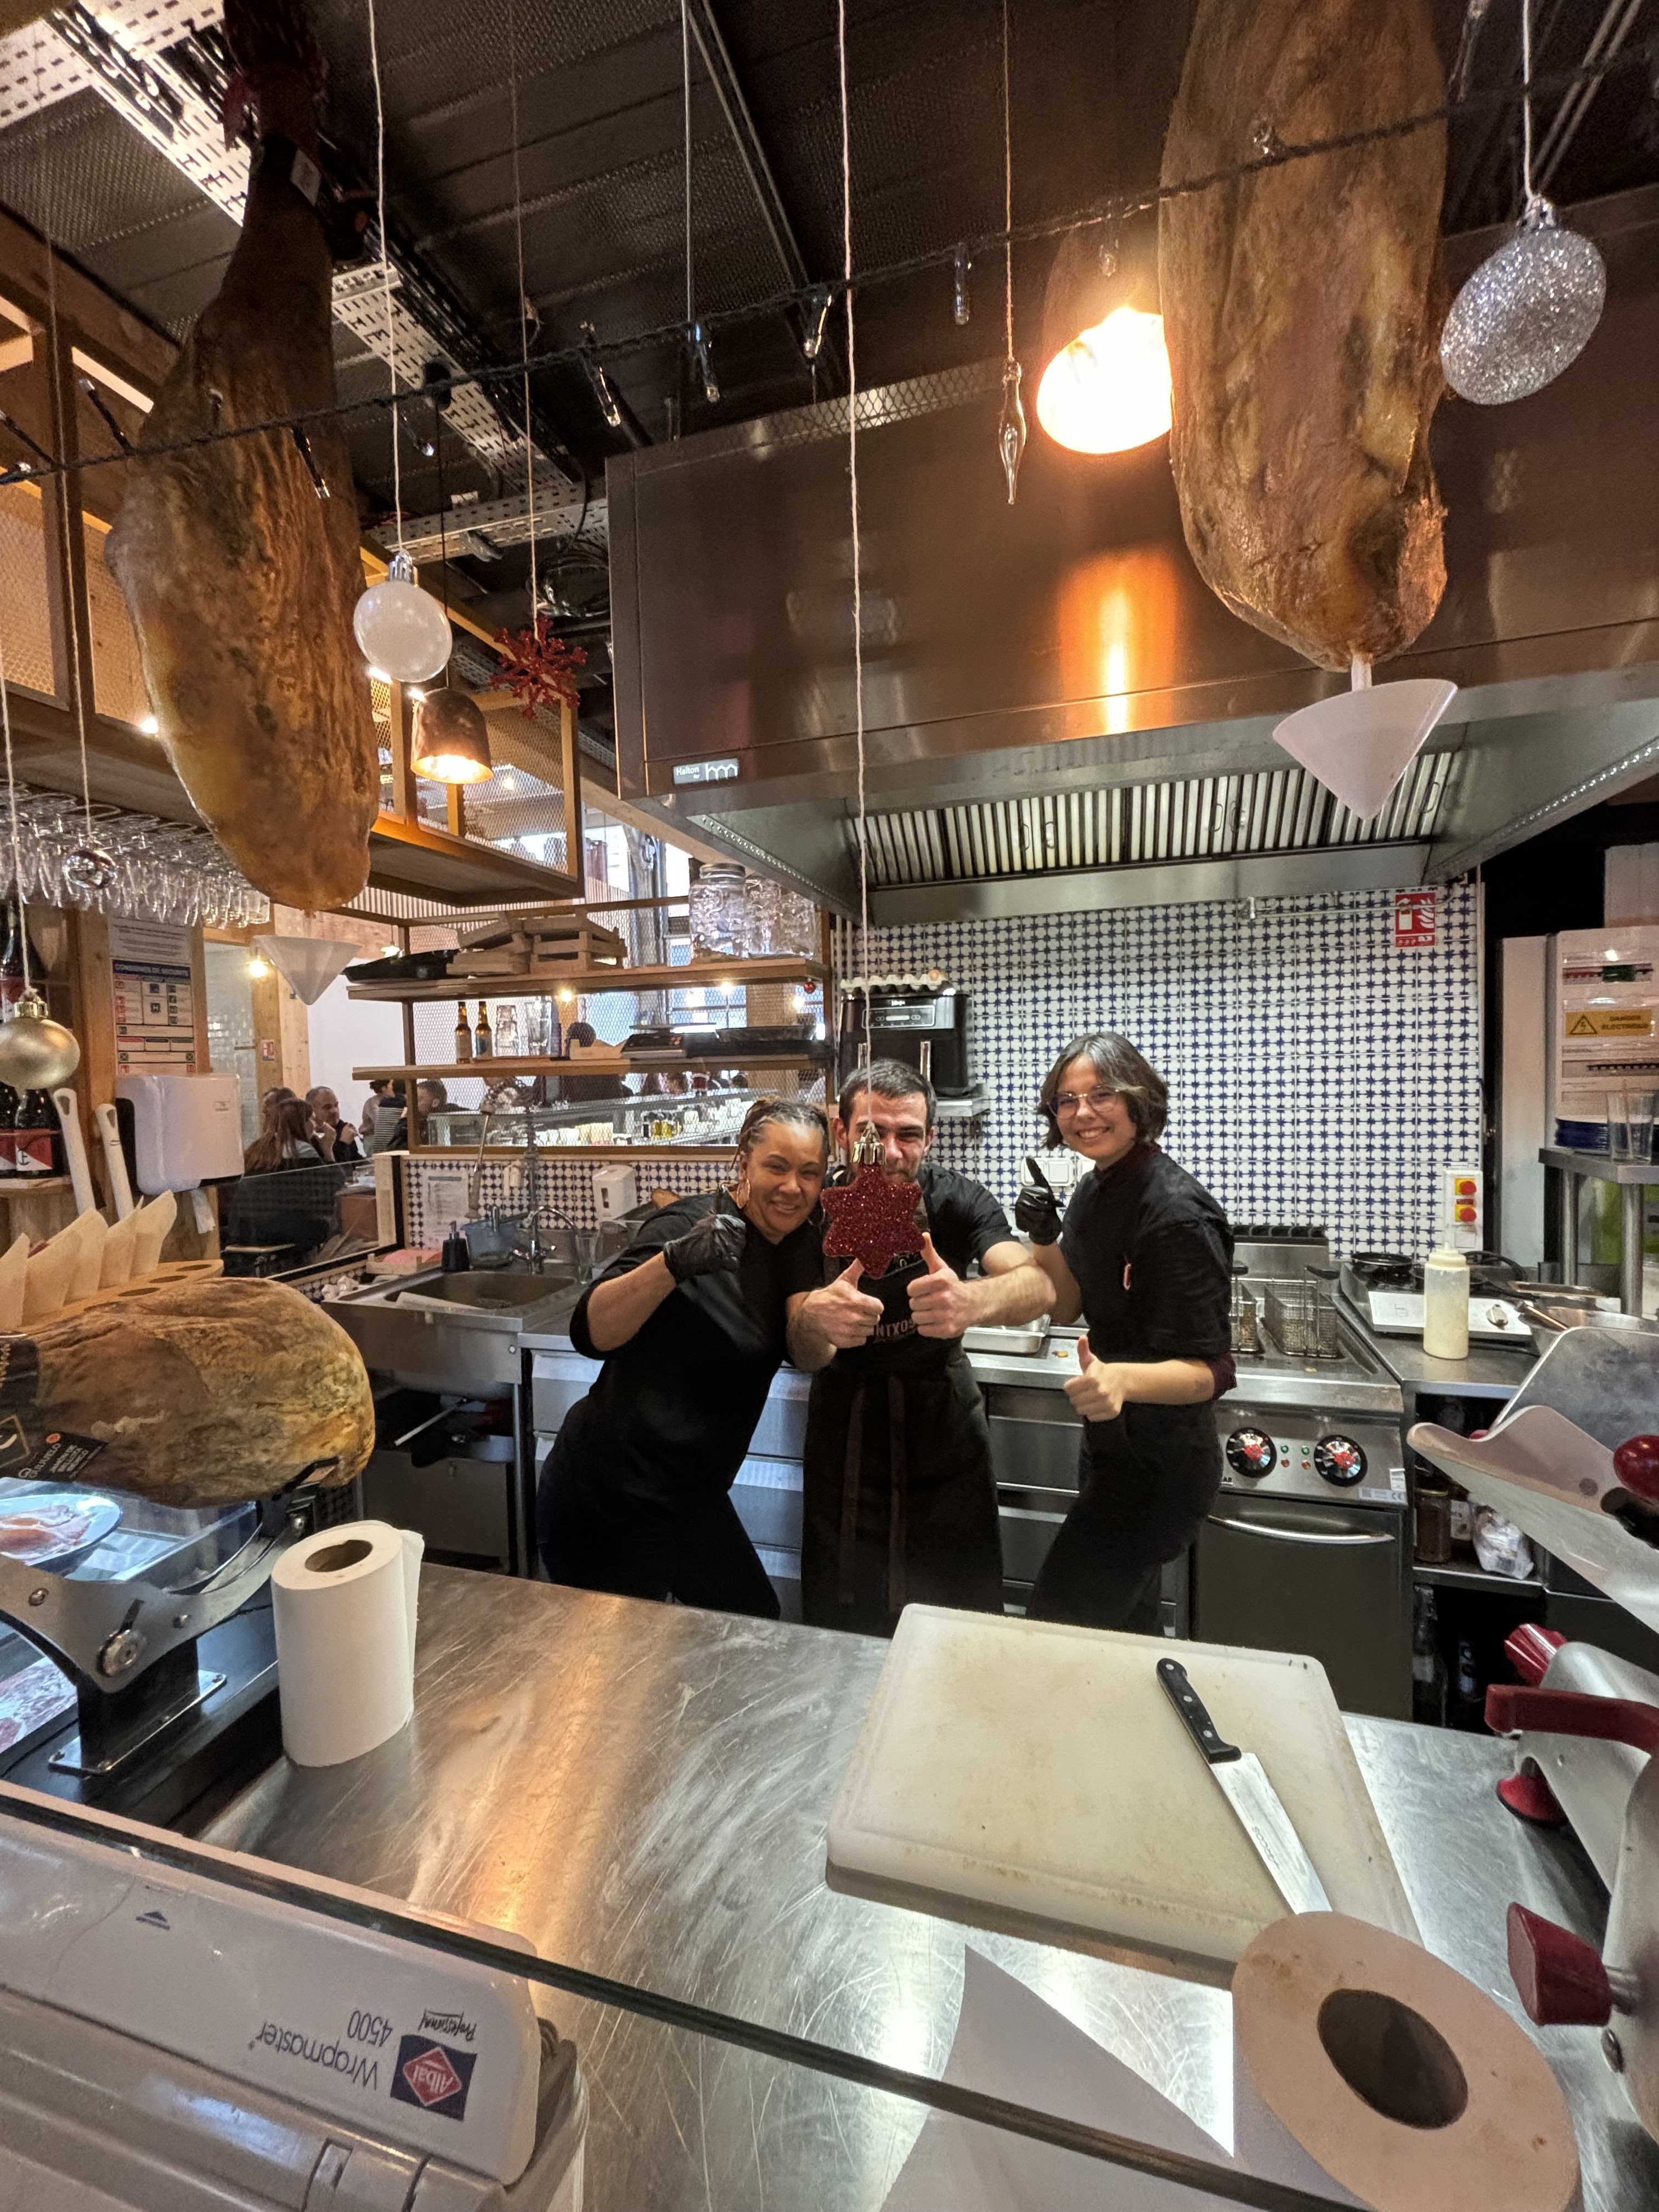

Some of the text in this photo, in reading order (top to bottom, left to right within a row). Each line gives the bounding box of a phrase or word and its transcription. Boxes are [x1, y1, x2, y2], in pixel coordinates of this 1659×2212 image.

[676, 766, 699, 776] Halton
[876, 1319, 916, 1338] NTXOS
[347, 2010, 393, 2047] 4500
[418, 2008, 477, 2042] Professional
[412, 2065, 454, 2096] Albal
